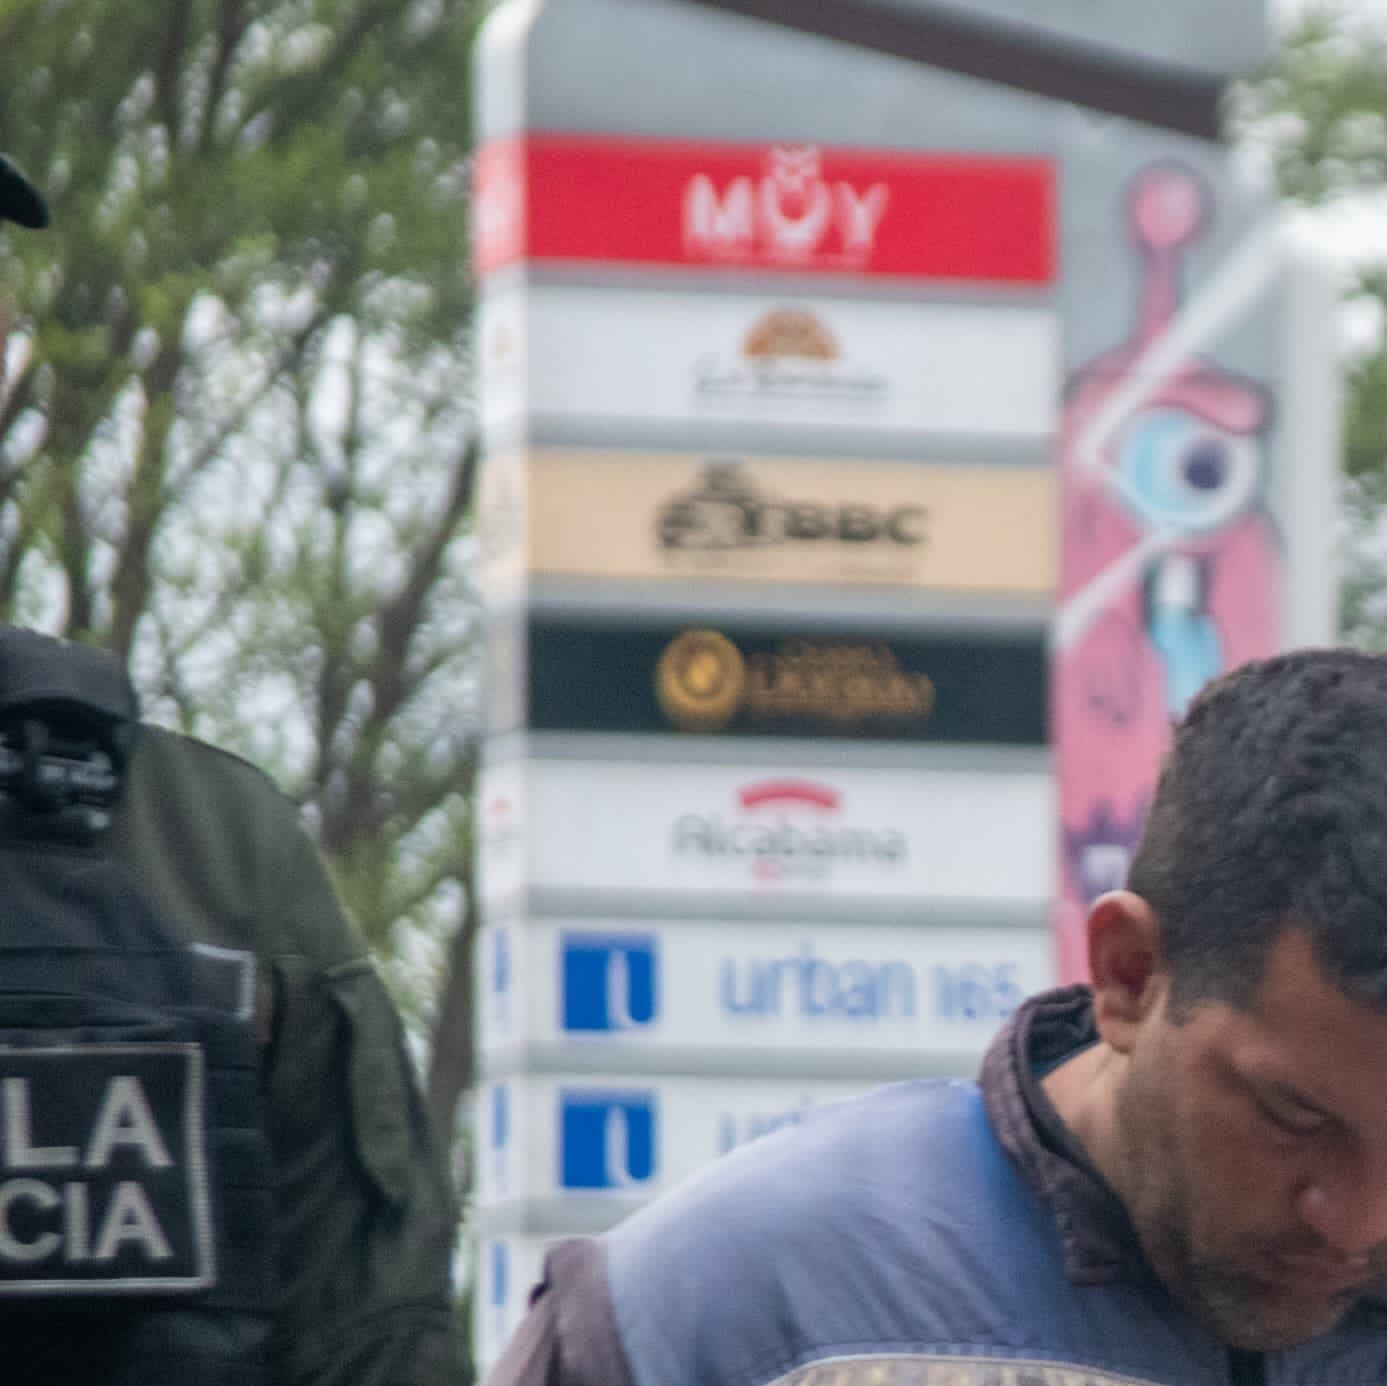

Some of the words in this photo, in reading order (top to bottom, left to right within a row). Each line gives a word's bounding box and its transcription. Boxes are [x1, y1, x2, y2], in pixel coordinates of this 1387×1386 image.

[684, 170, 889, 250] MUY
[783, 502, 930, 543] BBC
[718, 941, 917, 1020] urban
[935, 959, 1024, 1020] 165
[1, 1075, 175, 1168] LA
